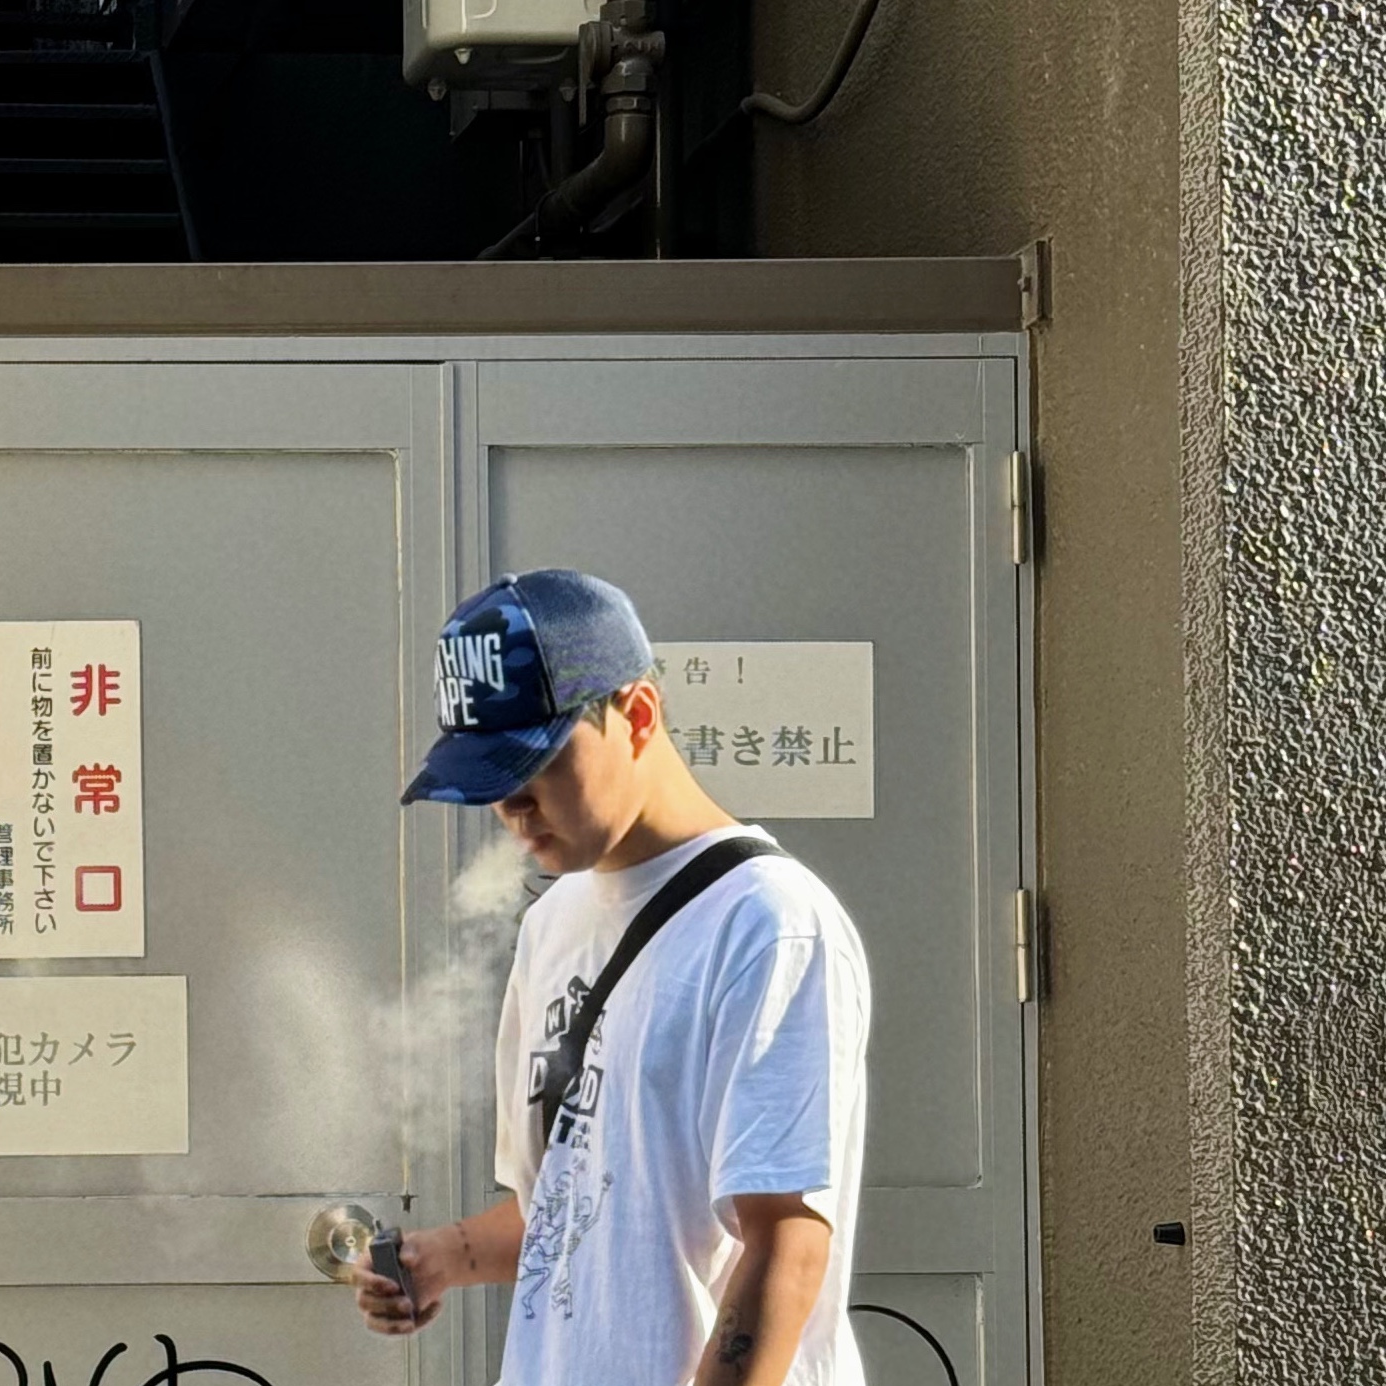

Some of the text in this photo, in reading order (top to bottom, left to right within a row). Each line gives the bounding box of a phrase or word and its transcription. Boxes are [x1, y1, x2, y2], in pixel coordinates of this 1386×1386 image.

[30, 646, 57, 935] 前に物を置かないで下さい
[70, 664, 122, 912] 非常口
[667, 724, 857, 767] 書き禁止
